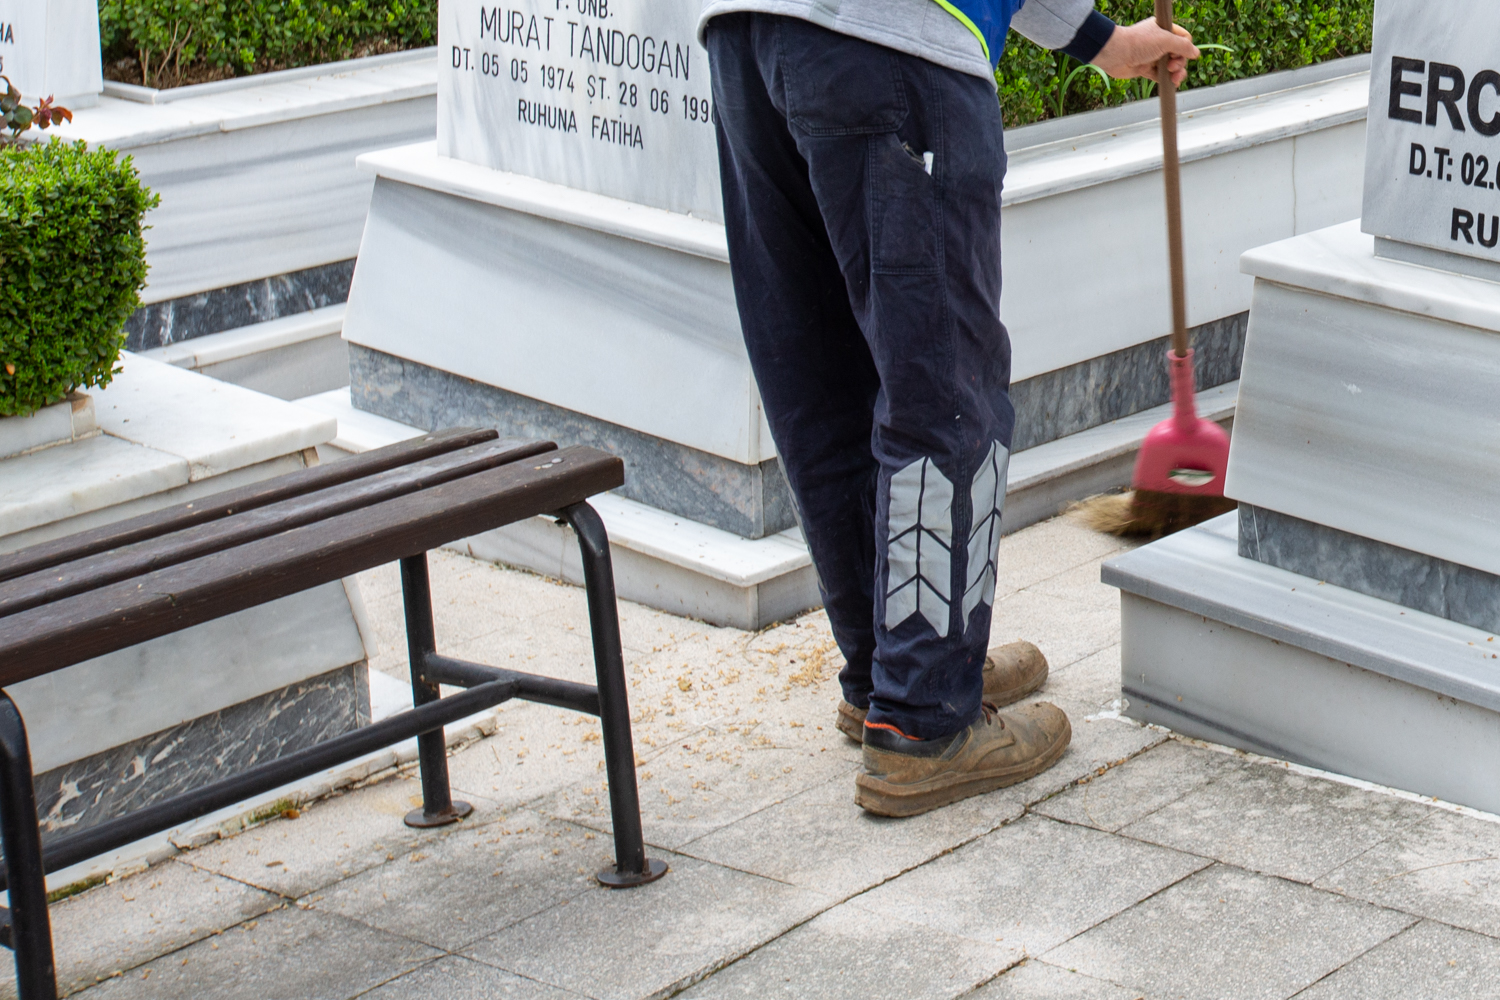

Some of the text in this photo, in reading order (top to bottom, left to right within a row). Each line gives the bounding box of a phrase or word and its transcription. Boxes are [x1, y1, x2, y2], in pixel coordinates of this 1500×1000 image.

[481, 6, 554, 51] MURAT
[452, 45, 714, 123] DT. 05 05 1974 ŞT. 28 06 199
[518, 98, 643, 150] RUHUNA FATİHA
[1409, 142, 1453, 182] D.T:
